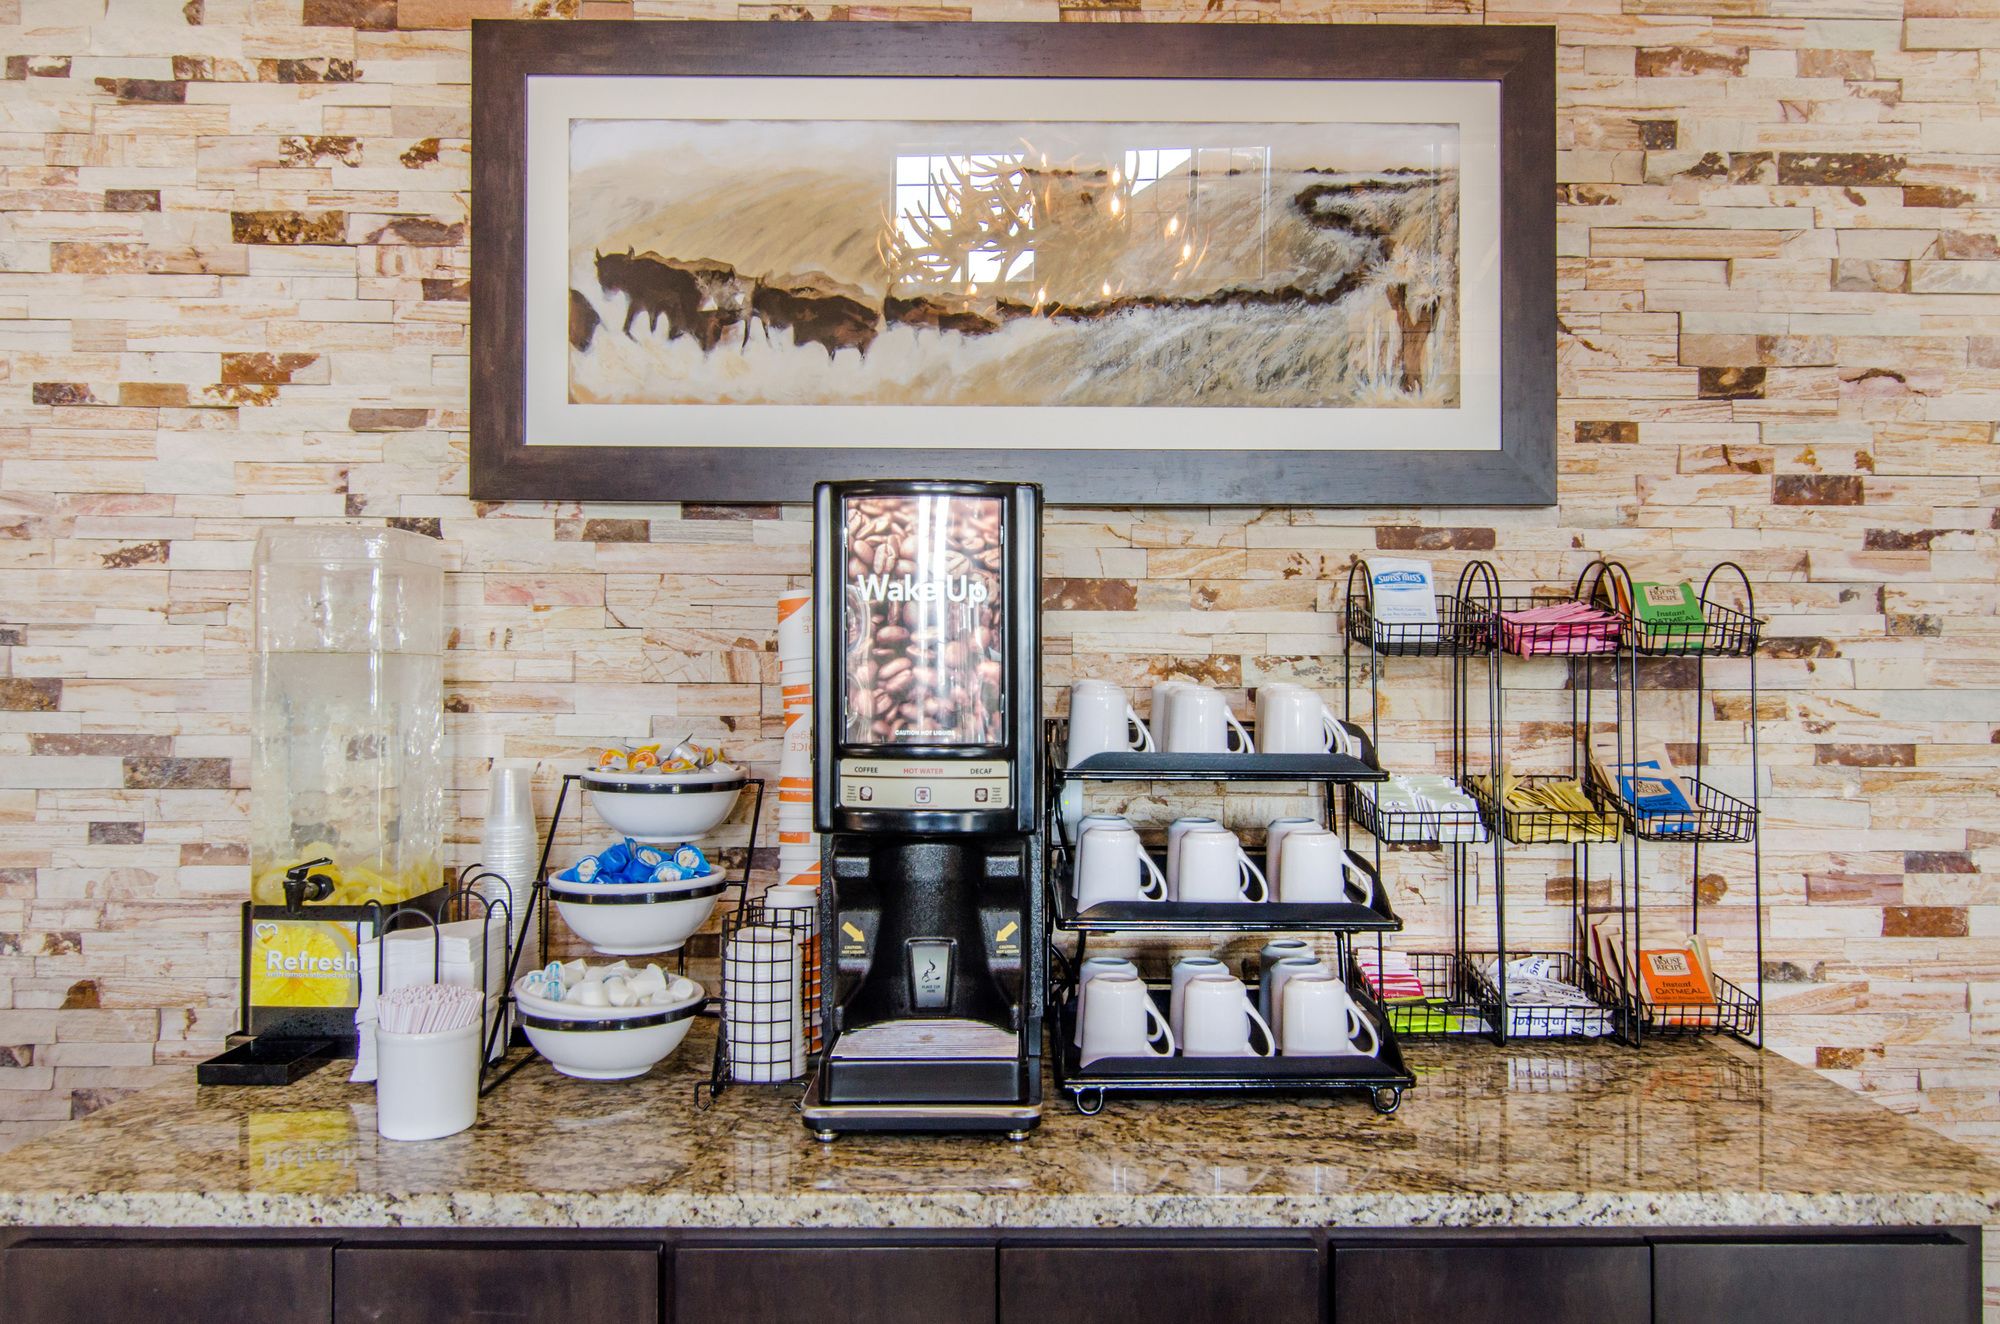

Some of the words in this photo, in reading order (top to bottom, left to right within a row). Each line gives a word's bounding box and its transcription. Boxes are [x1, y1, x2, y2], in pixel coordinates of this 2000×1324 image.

[857, 574, 938, 602] Wake
[947, 574, 987, 609] Up
[854, 766, 879, 774] COFFEE
[266, 950, 358, 972] Refresh
[1655, 987, 1706, 995] OATMEAL
